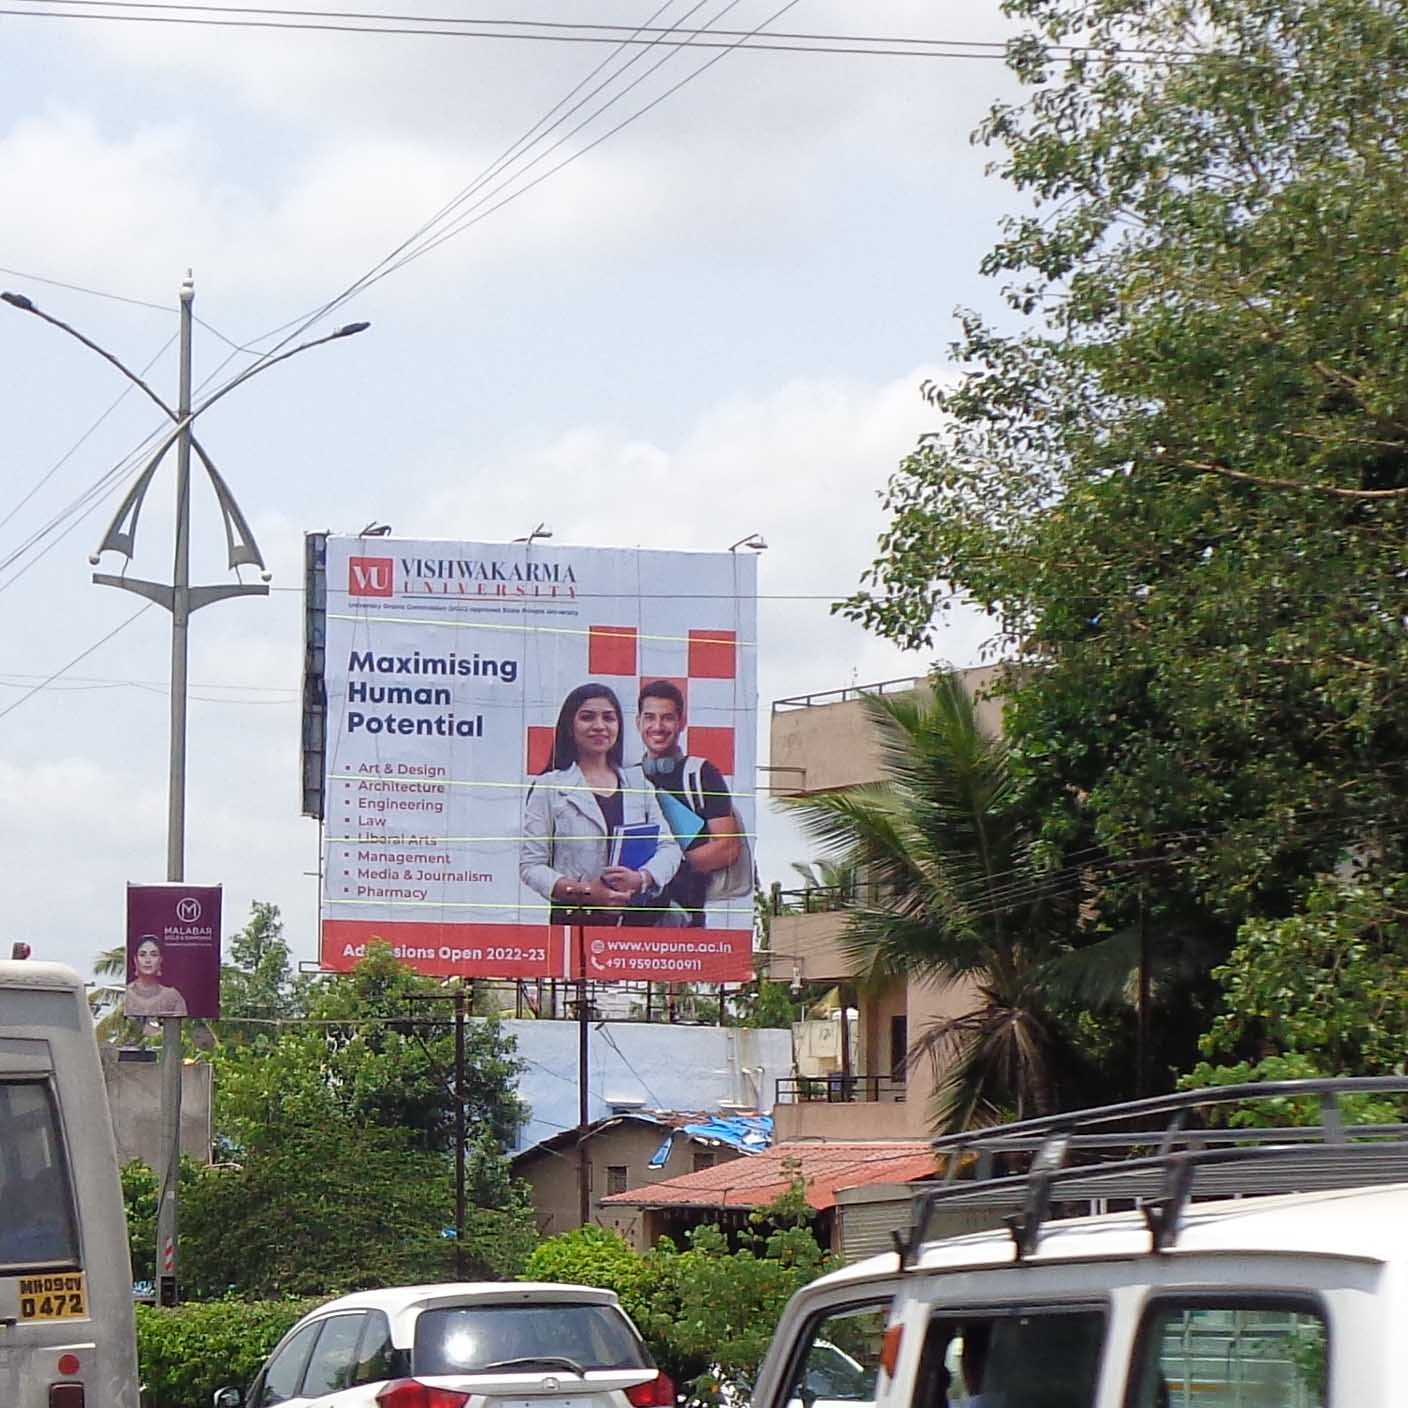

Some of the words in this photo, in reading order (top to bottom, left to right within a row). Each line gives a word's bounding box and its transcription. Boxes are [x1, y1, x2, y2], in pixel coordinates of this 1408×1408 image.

[352, 566, 389, 590] VU
[401, 559, 576, 583] VISHWAKARMA
[403, 582, 577, 598] UNIVERSITY
[348, 651, 518, 682] Maximising
[348, 681, 451, 705] Human
[348, 712, 483, 737] Potential
[358, 763, 380, 774] Art
[384, 763, 393, 774] &
[398, 764, 446, 777] Design
[358, 780, 445, 793] Architecture
[358, 798, 443, 813] Engineering
[358, 816, 386, 827] Law
[358, 851, 451, 865] Management
[358, 869, 399, 880] Media
[403, 871, 413, 881] &
[416, 870, 493, 882] Journalism
[357, 886, 428, 901] Pharmacy
[343, 943, 434, 959] Adsions
[439, 946, 482, 962] Open
[487, 948, 545, 961] 2022-23
[606, 958, 625, 970] +91
[22, 1294, 83, 1317] 0472
